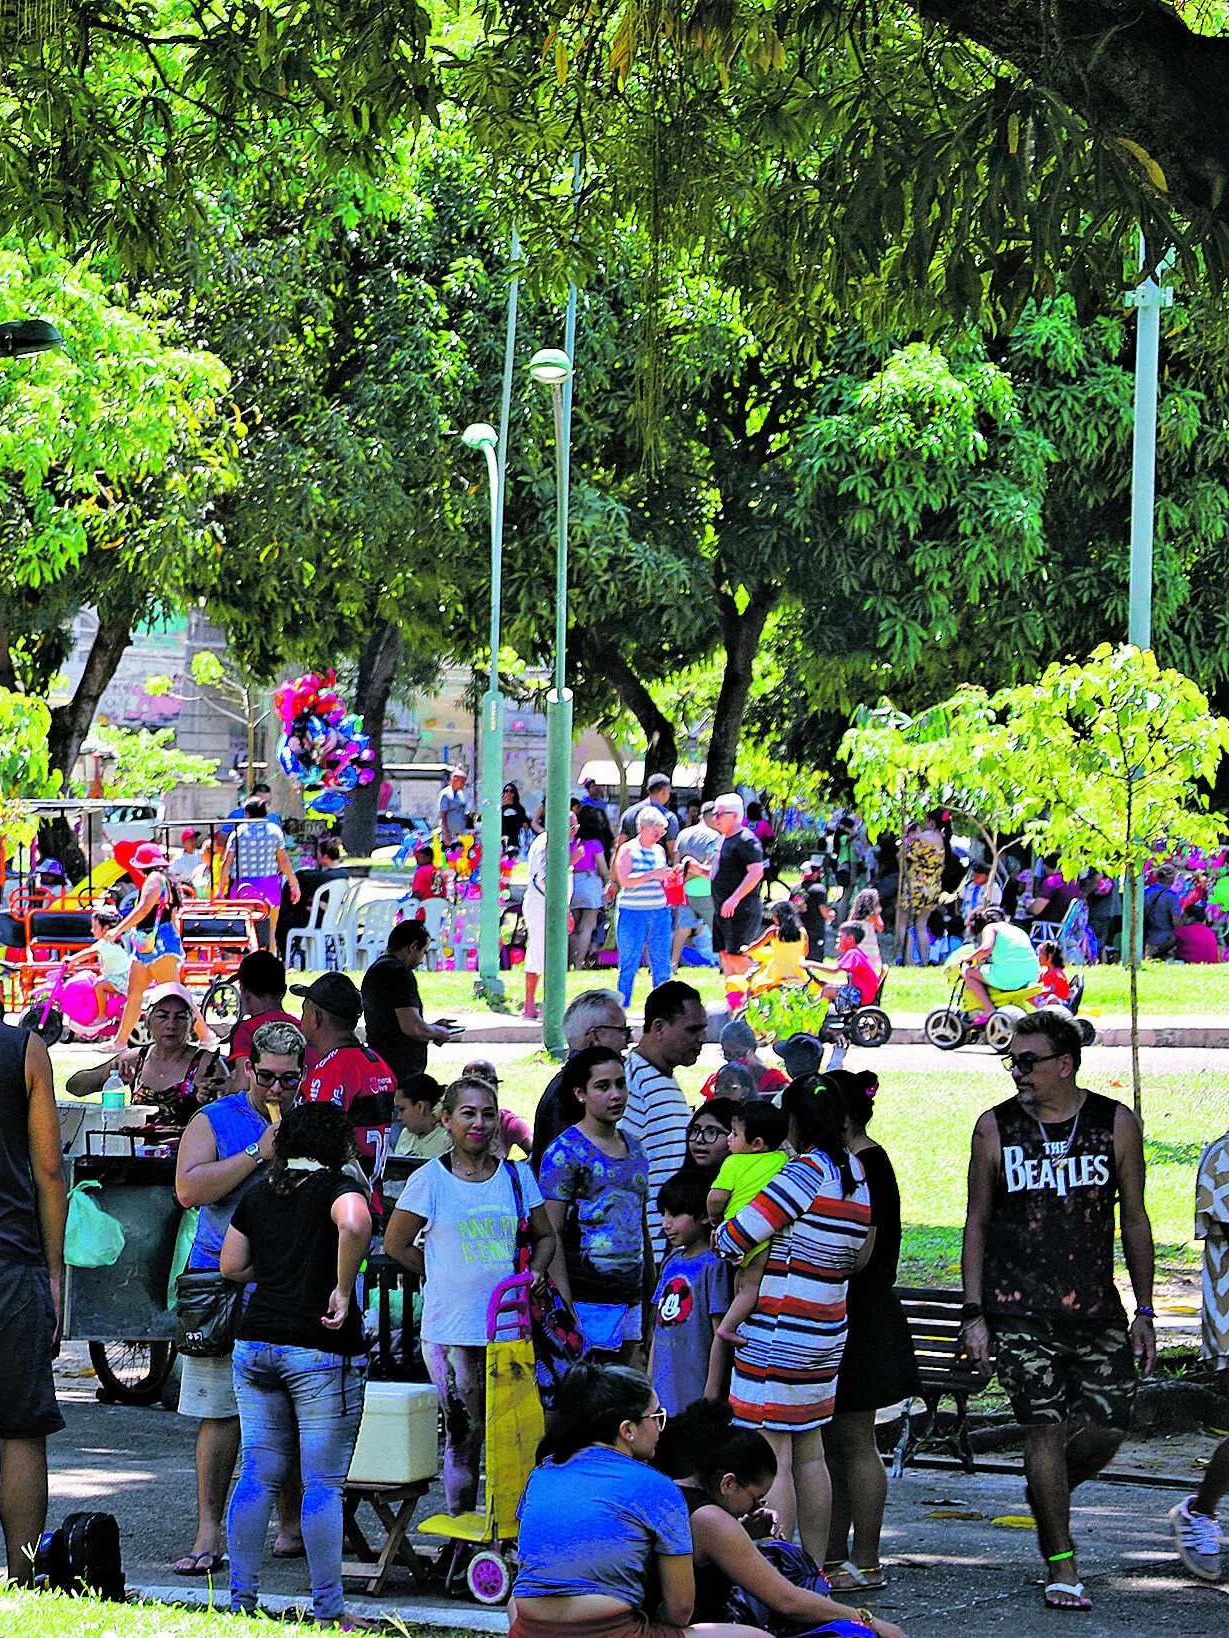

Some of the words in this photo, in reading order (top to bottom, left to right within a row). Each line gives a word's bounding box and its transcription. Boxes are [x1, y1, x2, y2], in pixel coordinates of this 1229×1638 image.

[1043, 1141, 1068, 1155] THE
[1003, 1145, 1110, 1197] BEATLES
[456, 1216, 499, 1240] HAVE
[499, 1215, 519, 1237] FU
[460, 1241, 477, 1263] IS
